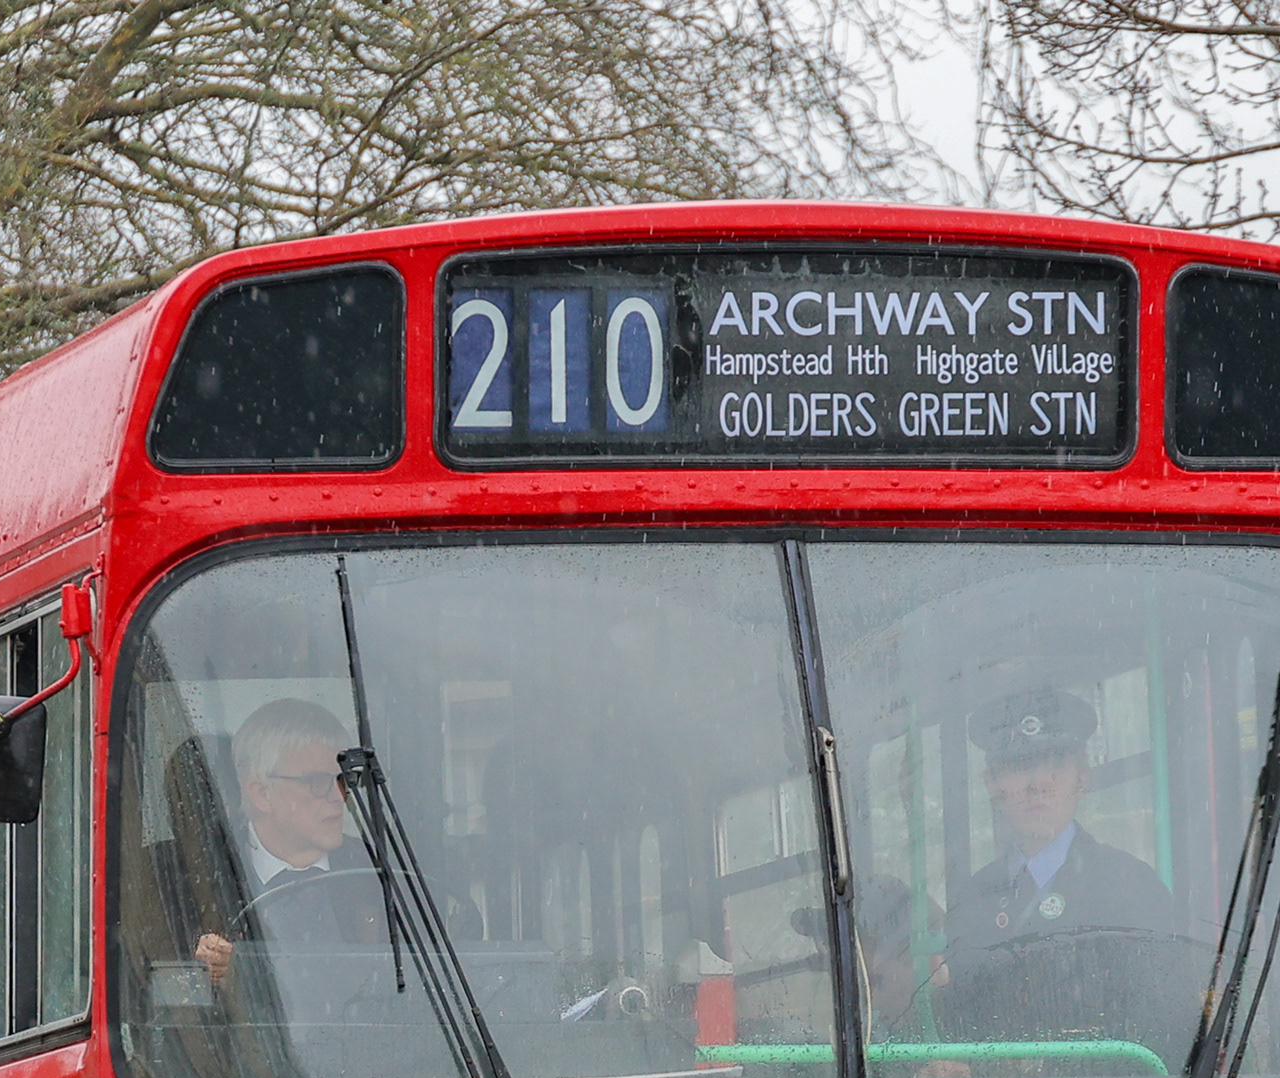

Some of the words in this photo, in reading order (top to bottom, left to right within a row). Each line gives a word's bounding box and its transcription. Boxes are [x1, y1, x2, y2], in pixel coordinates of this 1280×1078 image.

[709, 291, 990, 336] ARCHWAY
[1007, 291, 1105, 336] STN
[451, 297, 664, 427] 210
[706, 345, 832, 385] Hampstead
[847, 345, 888, 375] Hth
[916, 344, 1019, 384] Highgate
[1031, 344, 1113, 383] Village
[720, 392, 877, 437] GOLDERS
[898, 391, 1009, 436] GREEN
[1029, 391, 1096, 436] STN
